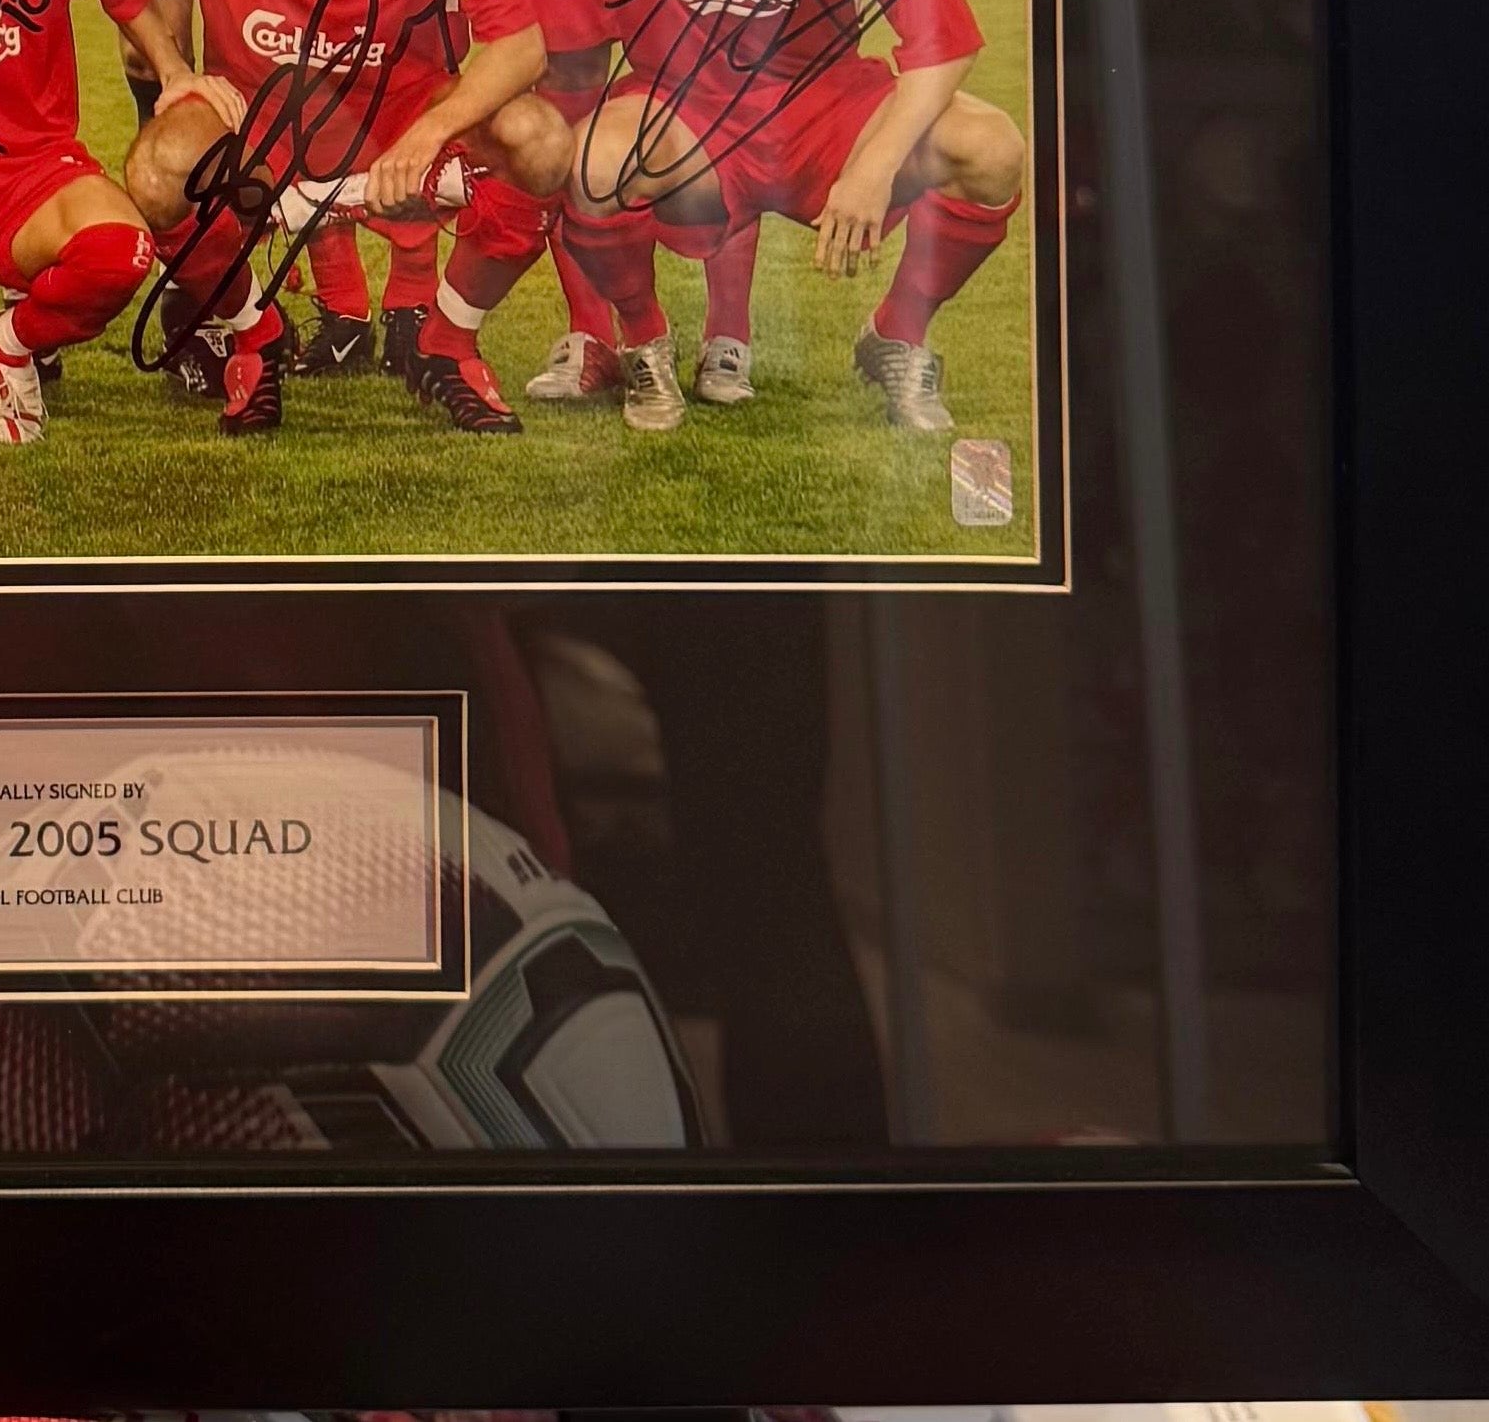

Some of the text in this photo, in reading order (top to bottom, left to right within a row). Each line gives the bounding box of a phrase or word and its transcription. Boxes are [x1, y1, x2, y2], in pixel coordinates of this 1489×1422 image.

[49, 782, 117, 800] SIGNED
[123, 781, 146, 799] BY
[9, 820, 122, 857] 2005
[139, 819, 312, 864] SQUAD
[16, 888, 111, 906] FOOTBALL
[116, 887, 164, 905] CLUB
